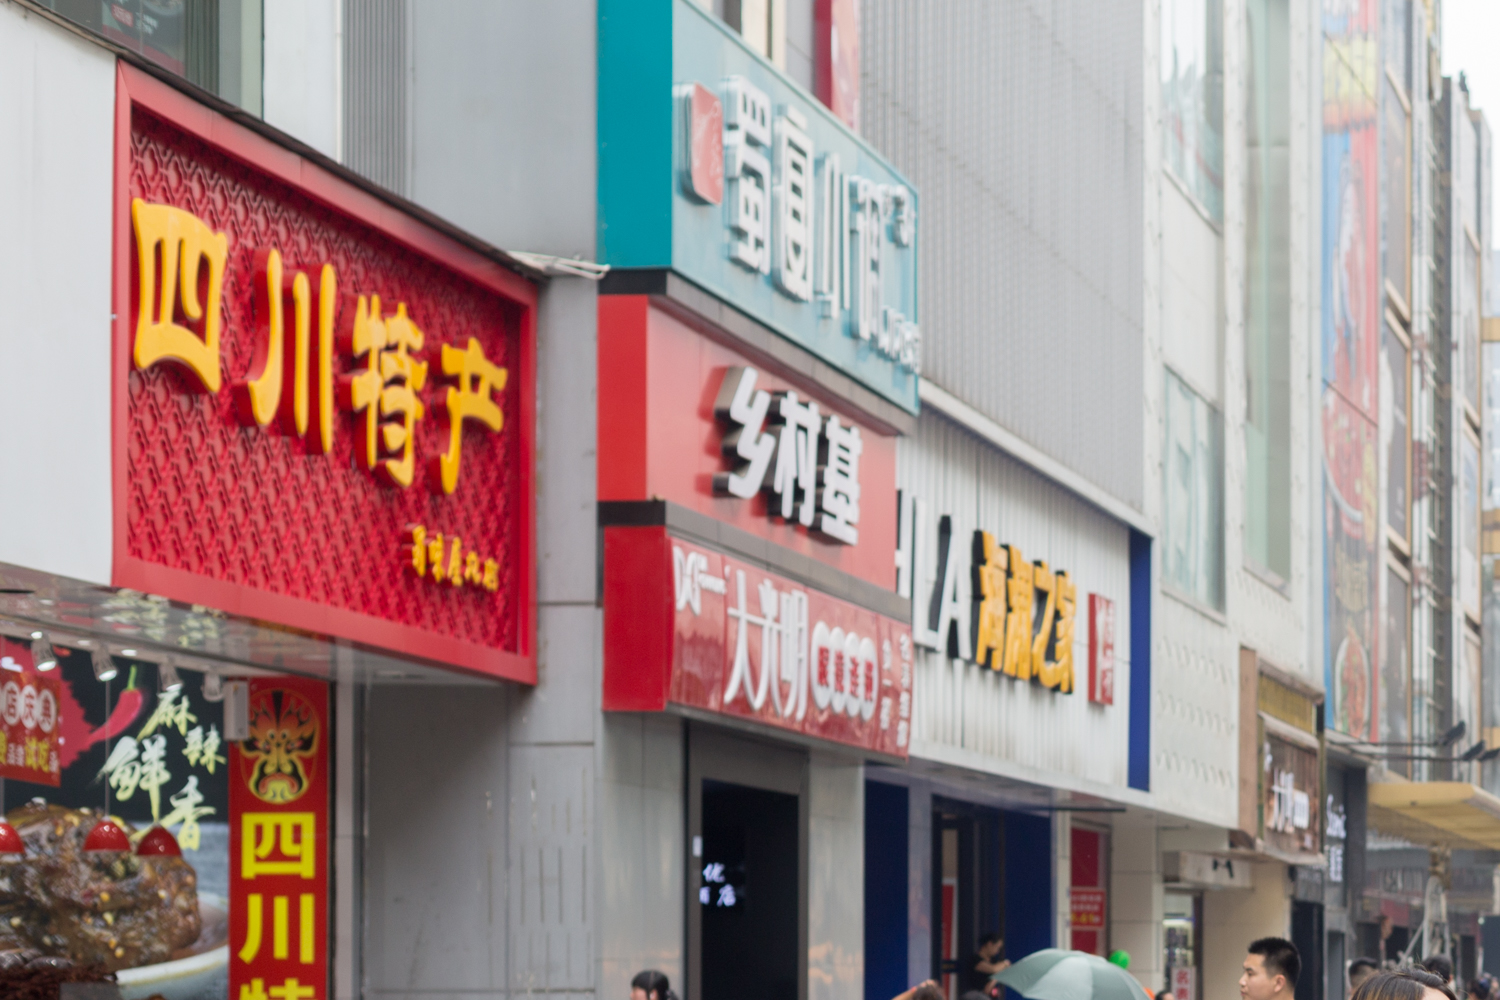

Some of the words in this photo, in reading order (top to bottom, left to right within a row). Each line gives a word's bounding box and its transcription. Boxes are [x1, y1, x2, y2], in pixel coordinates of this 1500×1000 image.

[132, 197, 509, 495] 四川特产
[727, 365, 863, 547] 乡村基
[975, 530, 1078, 694] 海澜之家
